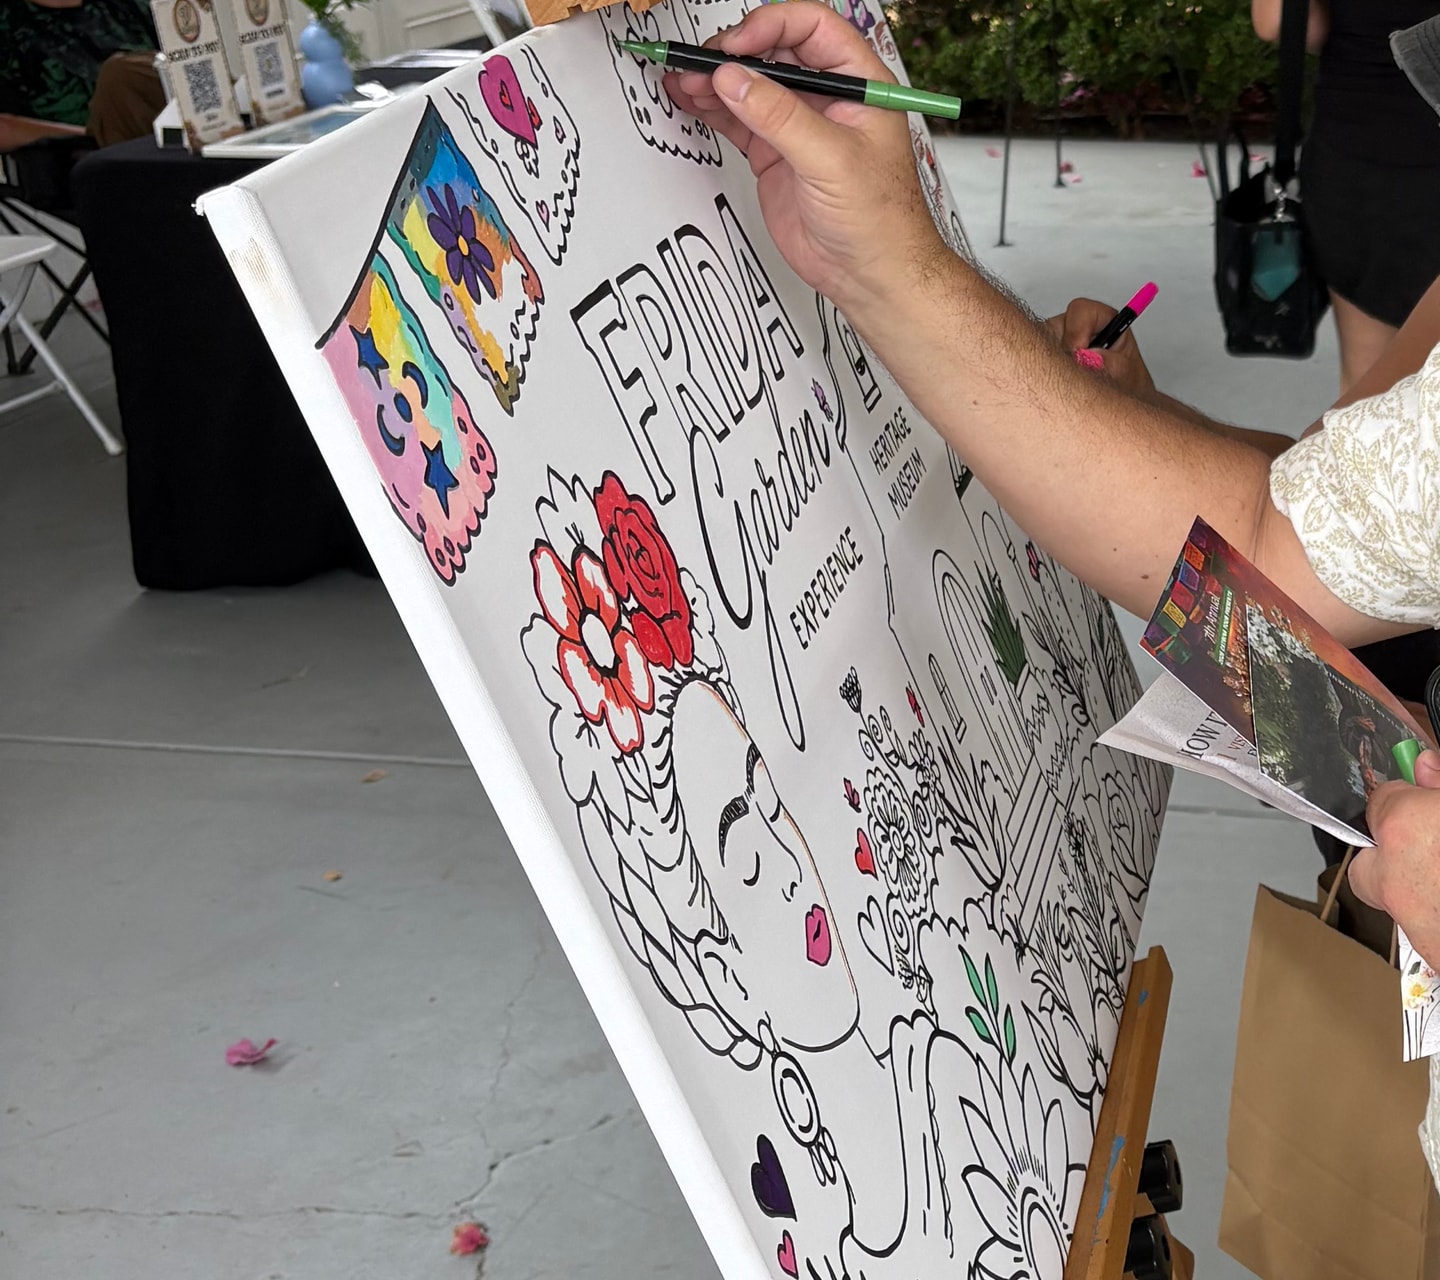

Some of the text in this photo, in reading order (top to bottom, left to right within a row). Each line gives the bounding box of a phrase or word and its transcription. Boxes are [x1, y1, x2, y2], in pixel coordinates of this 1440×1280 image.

[569, 192, 805, 507] FRIDA
[868, 406, 912, 476] HERITAGE
[887, 446, 928, 520] MUSEUM
[790, 526, 865, 651] EXPERIENCE
